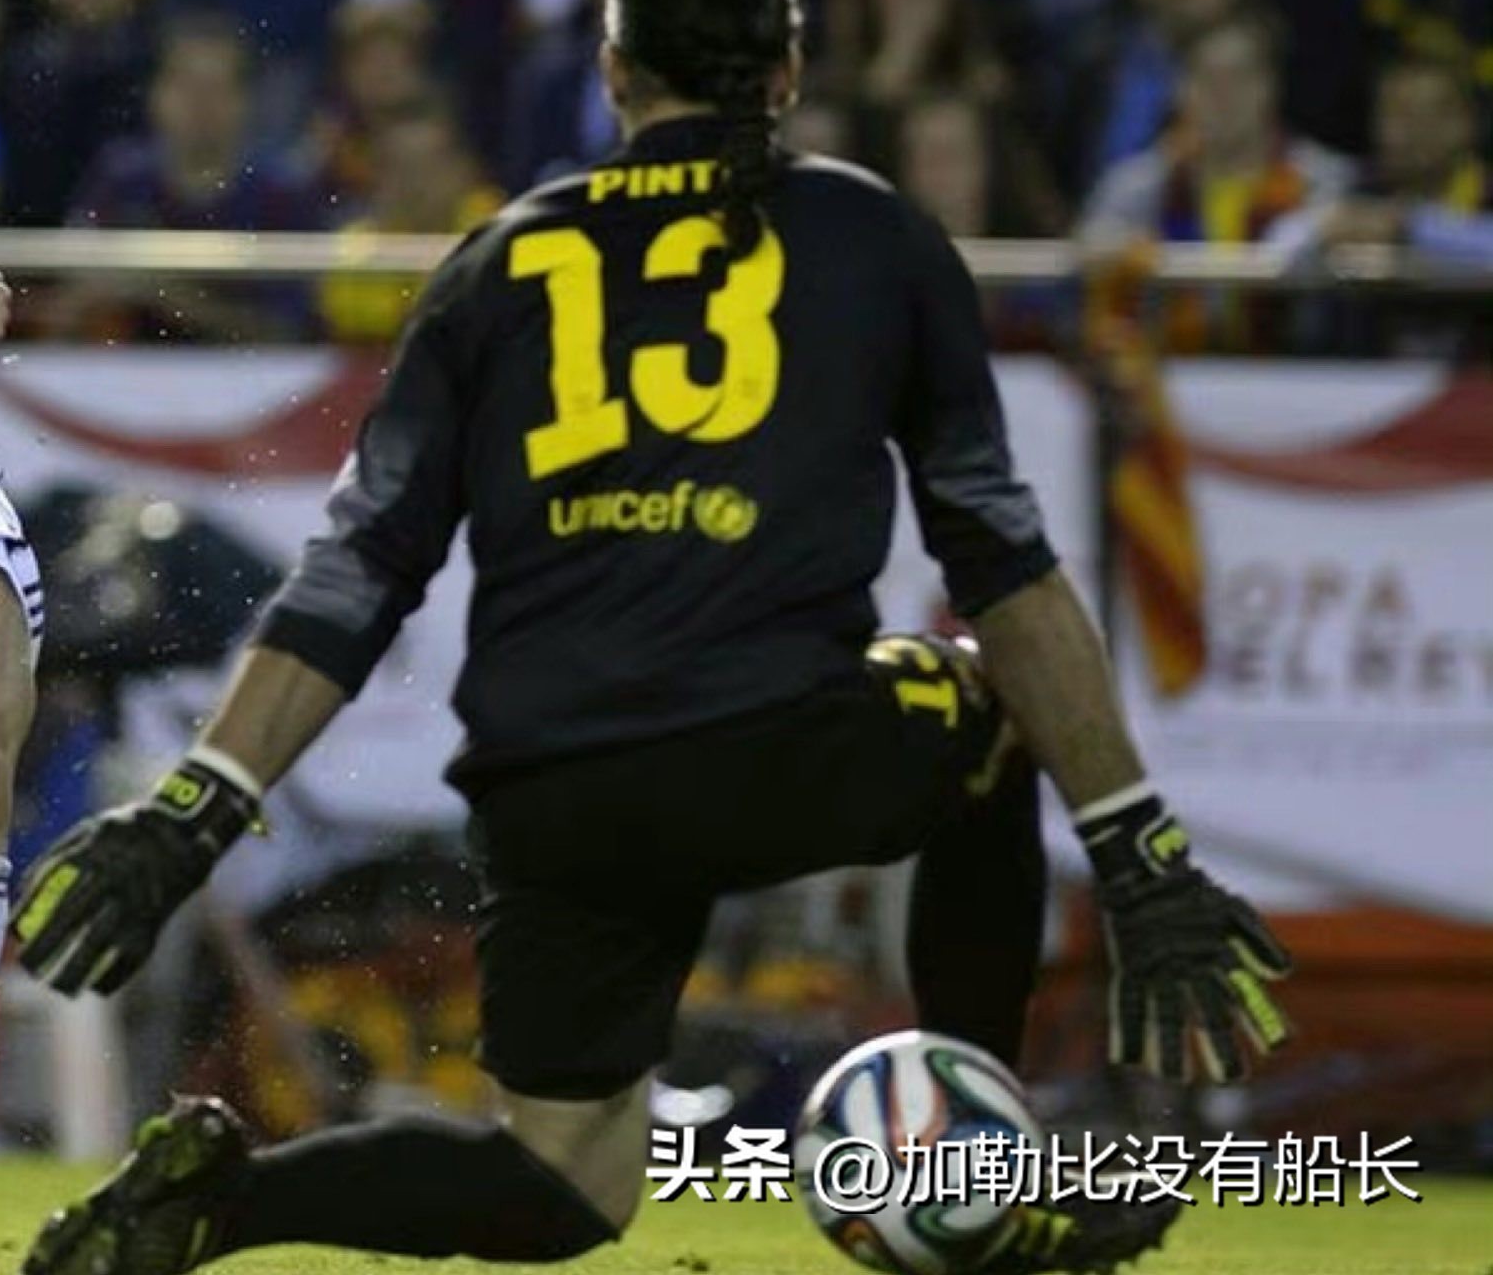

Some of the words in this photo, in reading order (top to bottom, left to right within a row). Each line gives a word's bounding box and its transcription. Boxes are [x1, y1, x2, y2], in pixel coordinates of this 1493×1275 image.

[588, 159, 730, 204] PINT
[510, 215, 786, 481] 13
[548, 480, 696, 536] unicef
